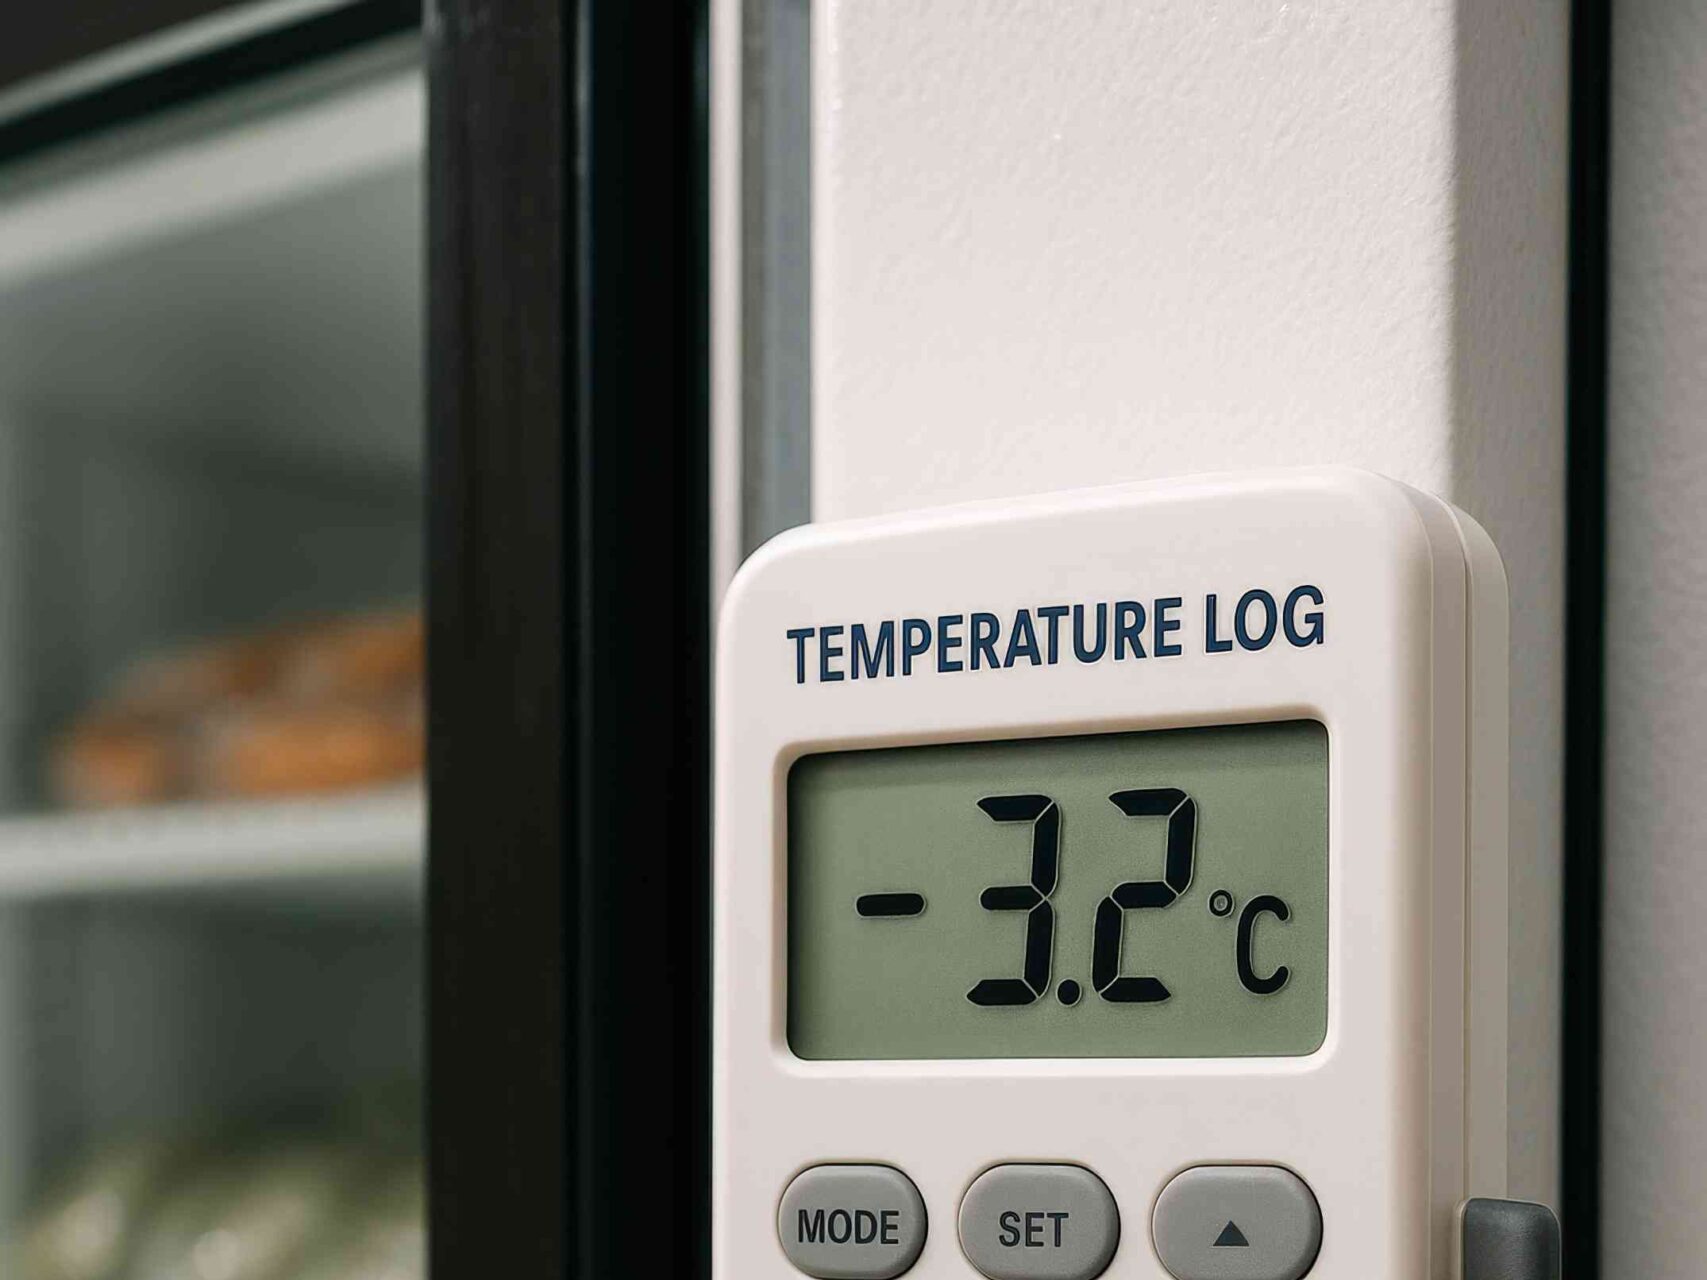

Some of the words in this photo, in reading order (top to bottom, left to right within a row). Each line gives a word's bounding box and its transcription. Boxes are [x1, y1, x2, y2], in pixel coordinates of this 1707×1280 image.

[787, 597, 1182, 684] TEMPERATURE
[1206, 585, 1324, 653] LOG
[1210, 890, 1288, 994] °C
[799, 1209, 899, 1244] MODE
[999, 1211, 1069, 1247] SET
